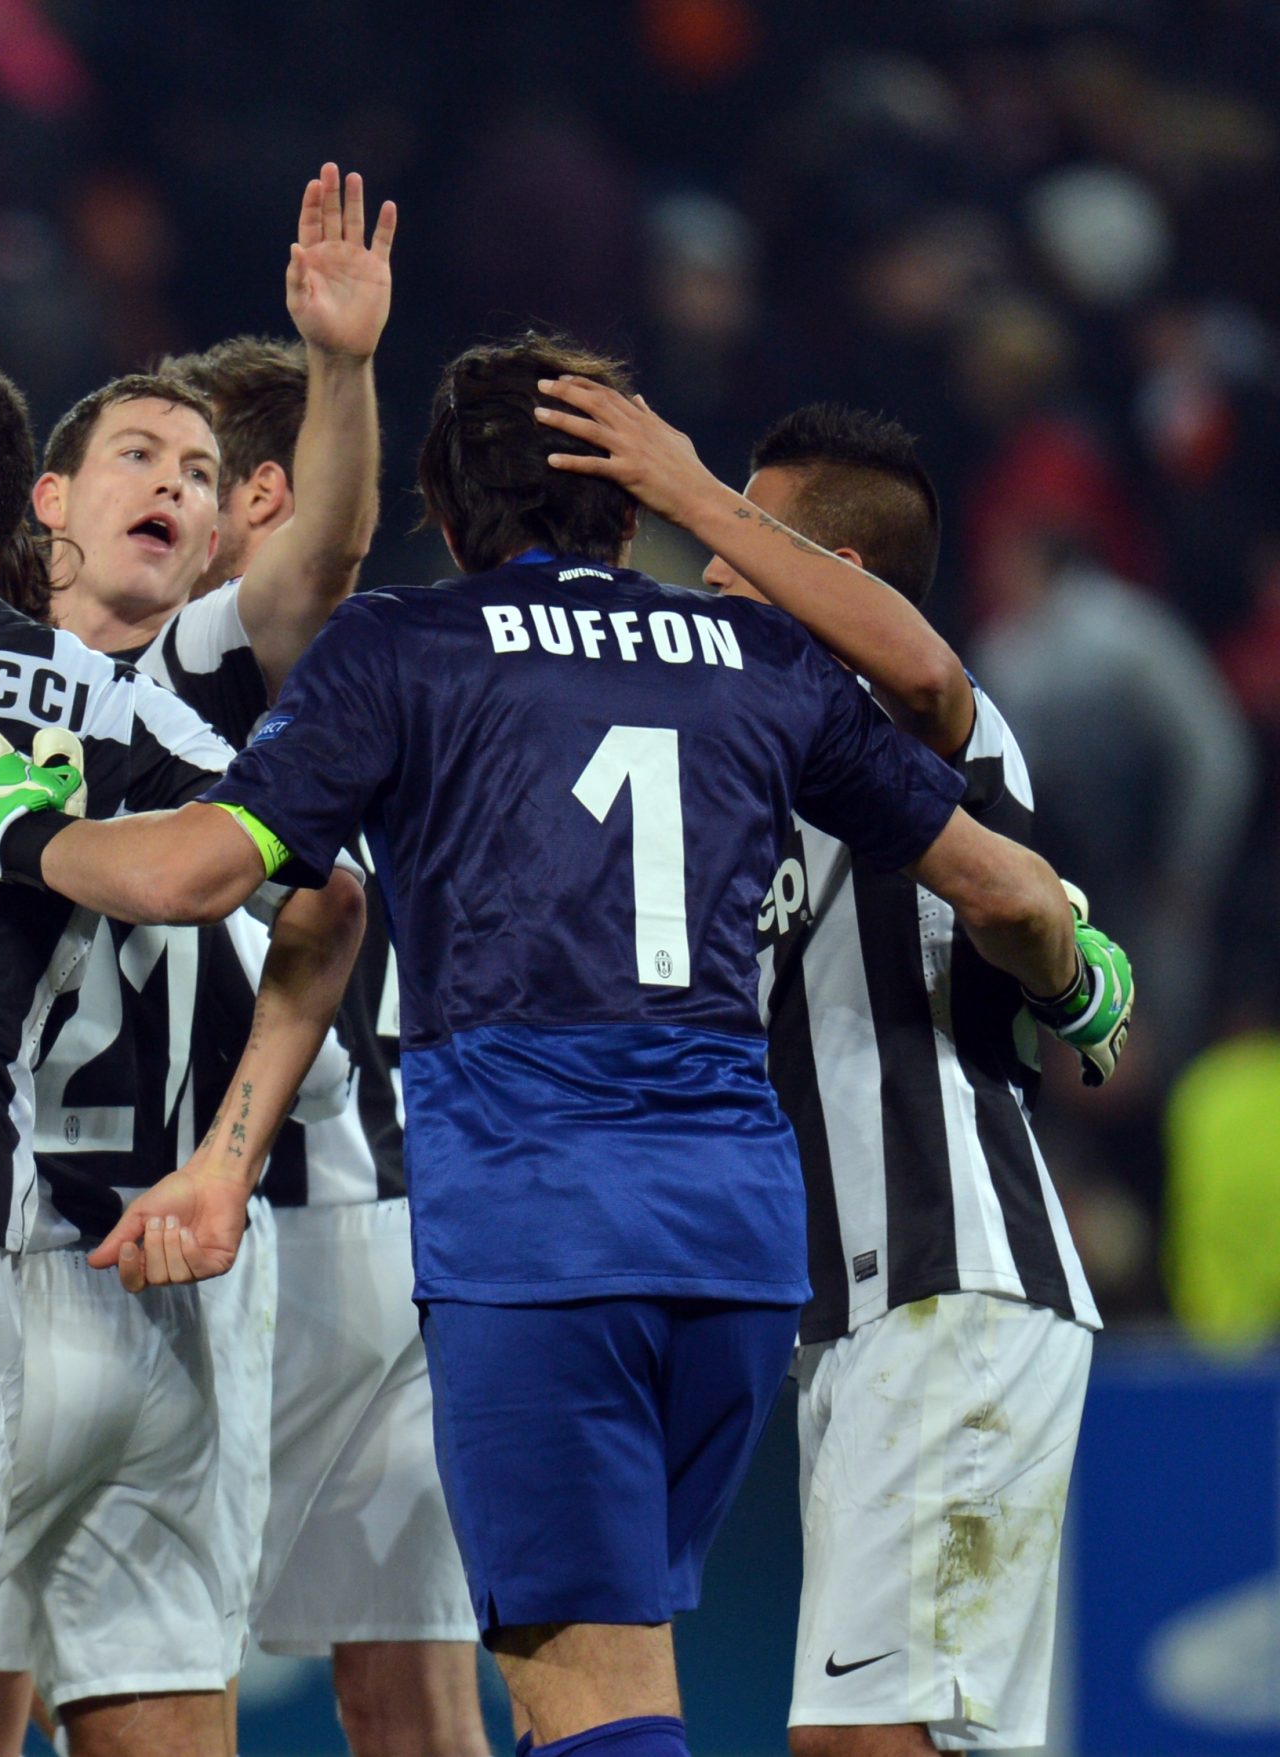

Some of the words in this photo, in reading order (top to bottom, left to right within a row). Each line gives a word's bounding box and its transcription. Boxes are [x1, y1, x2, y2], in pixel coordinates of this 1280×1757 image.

[481, 603, 744, 670] BUFFON
[558, 567, 614, 582] JUVENTUS
[571, 724, 691, 988] 1
[33, 913, 200, 1154] 21
